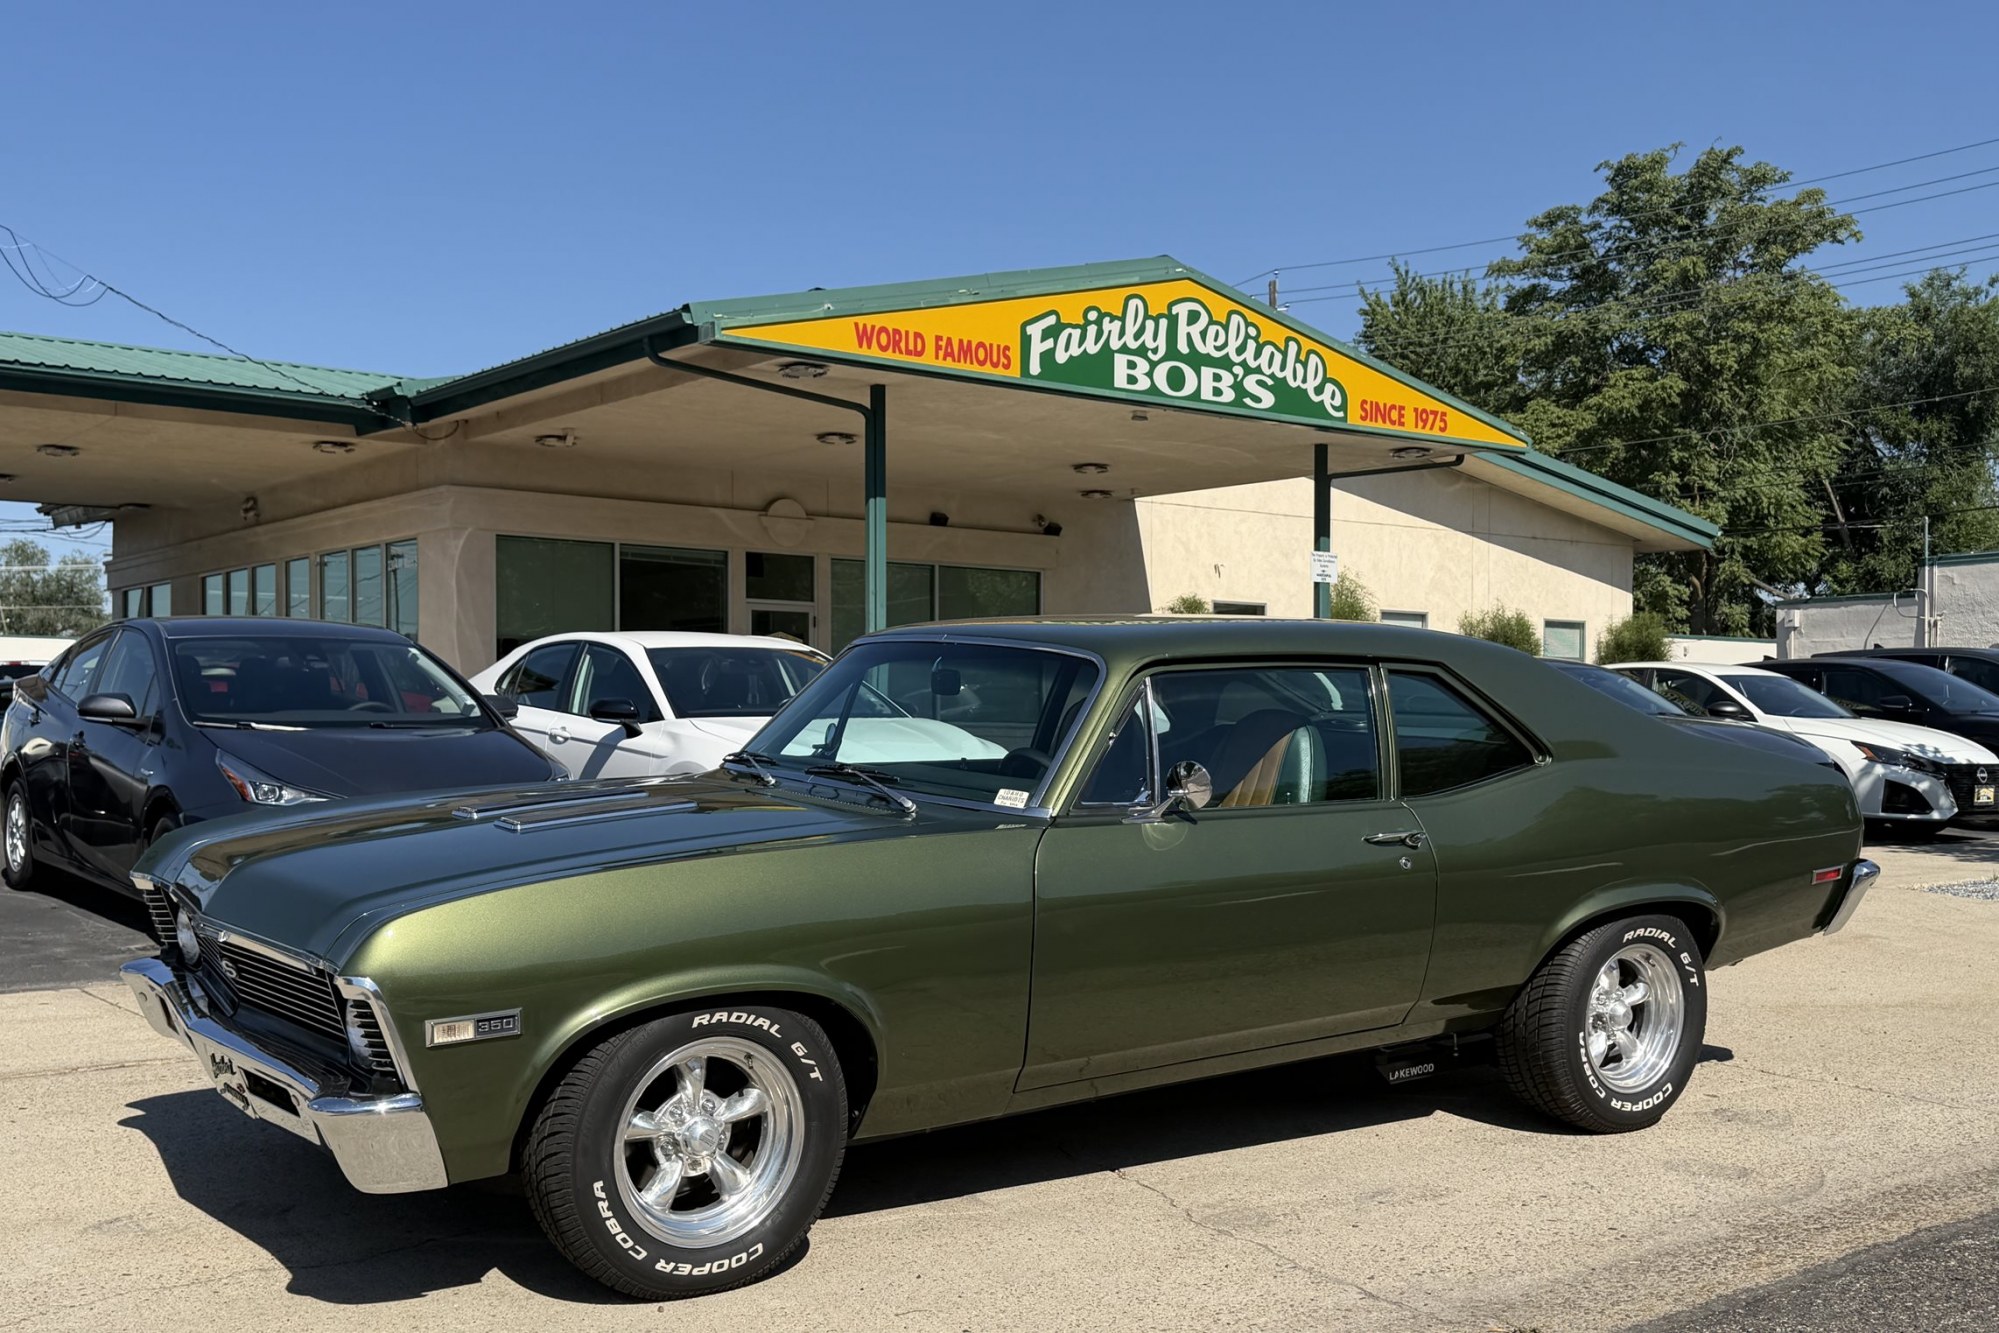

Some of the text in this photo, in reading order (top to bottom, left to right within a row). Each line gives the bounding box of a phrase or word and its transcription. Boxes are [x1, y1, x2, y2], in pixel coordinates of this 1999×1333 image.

[854, 322, 1012, 370] WORLD FAMOUS
[1026, 298, 1345, 418] Fairly Reliable
[1114, 353, 1276, 409] BOB'S
[1360, 399, 1448, 433] SINCE 1975
[1622, 927, 1699, 986] RADIAL G/T
[478, 1018, 513, 1032] 350
[692, 1012, 824, 1082] RADIAL G/T
[1389, 1063, 1435, 1080] LAKEWOOD
[1578, 1031, 1673, 1112] COOPER COBRA
[592, 1180, 764, 1275] COOPER COBRA
